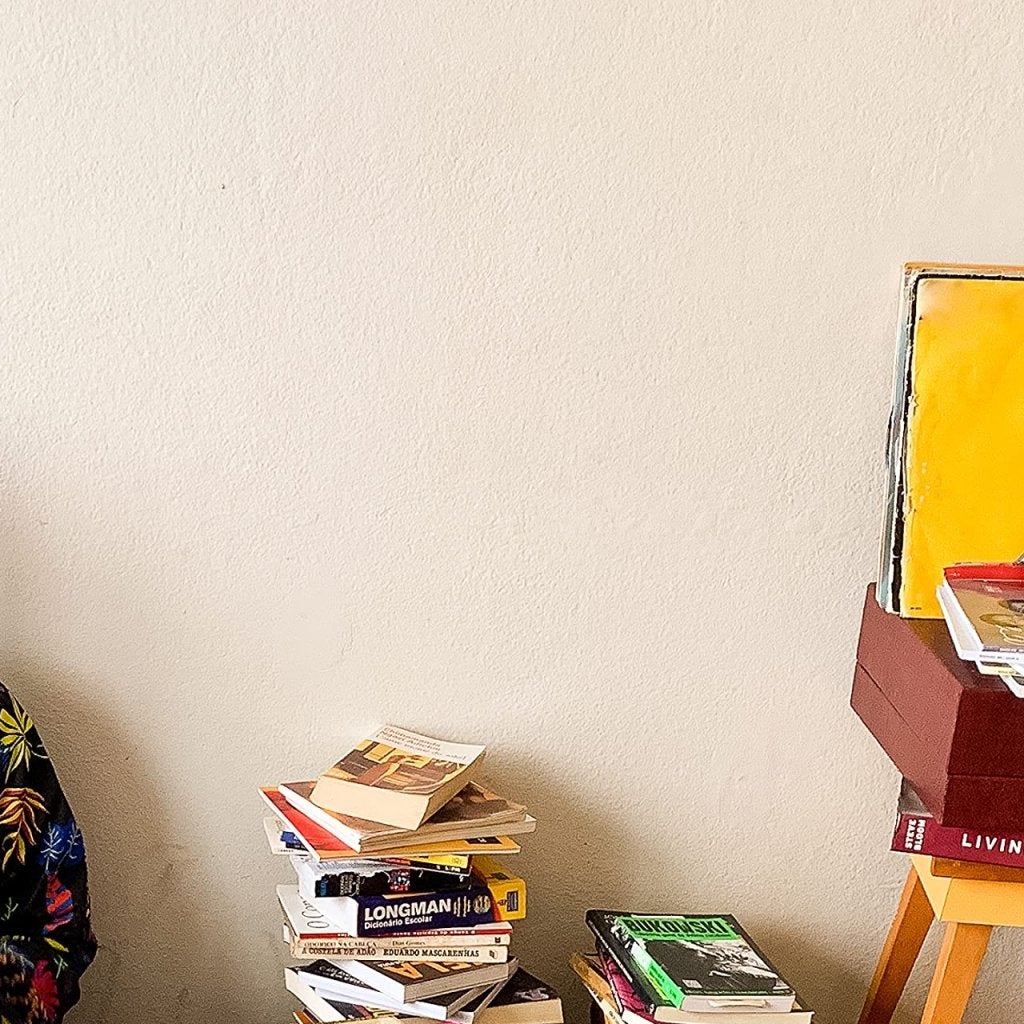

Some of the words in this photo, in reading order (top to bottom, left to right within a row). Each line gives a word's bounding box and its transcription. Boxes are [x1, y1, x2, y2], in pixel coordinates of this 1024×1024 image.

[904, 819, 917, 849] STEVE
[916, 819, 926, 850] BLOOM
[364, 896, 453, 920] LONGMAN
[364, 915, 403, 930] Dicionário
[404, 913, 433, 926] Escolar
[627, 918, 730, 937] BUKOWSKI
[344, 947, 356, 956] DE
[383, 948, 420, 957] EDUARDO
[422, 949, 480, 958] MASCARENHAS
